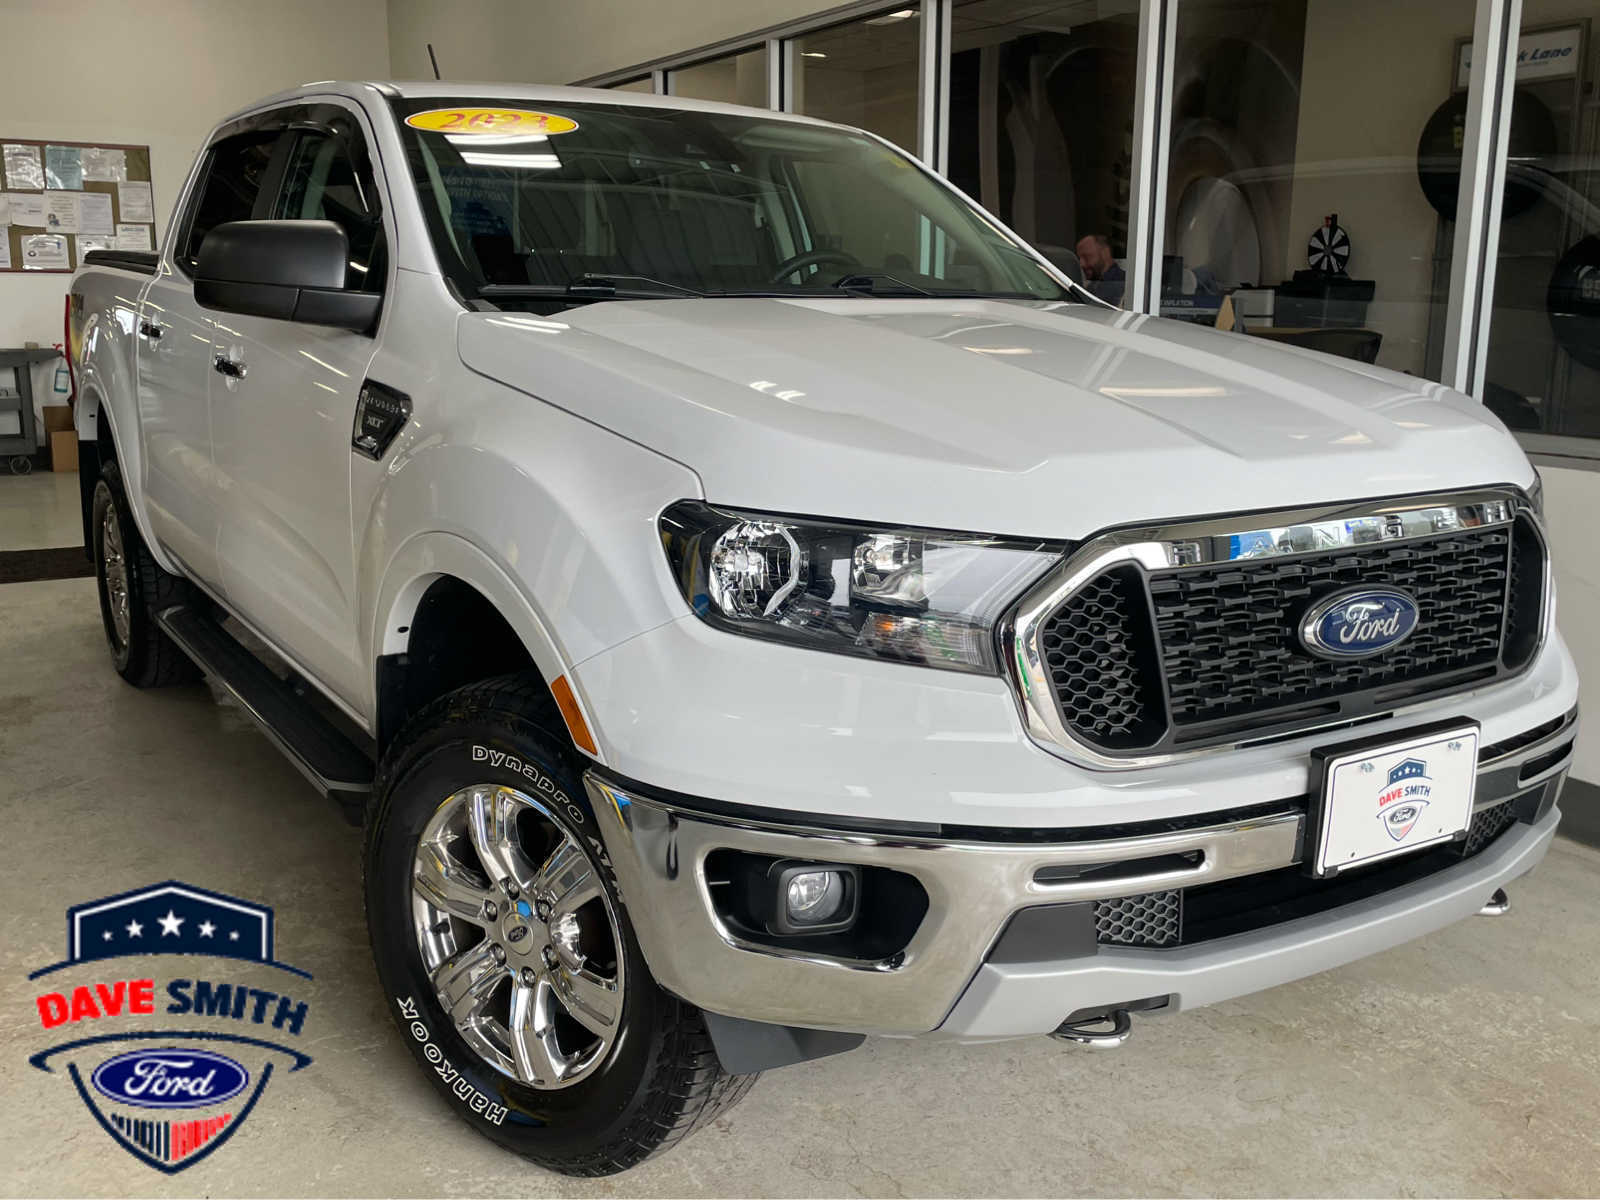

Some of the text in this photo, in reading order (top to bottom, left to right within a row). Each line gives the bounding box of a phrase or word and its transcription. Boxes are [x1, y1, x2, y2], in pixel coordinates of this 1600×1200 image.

[1529, 46, 1573, 61] Lane
[366, 415, 384, 429] XLT
[1339, 601, 1400, 644] Ford
[1379, 785, 1431, 807] DAVE SMITH
[1393, 808, 1413, 822] Ford
